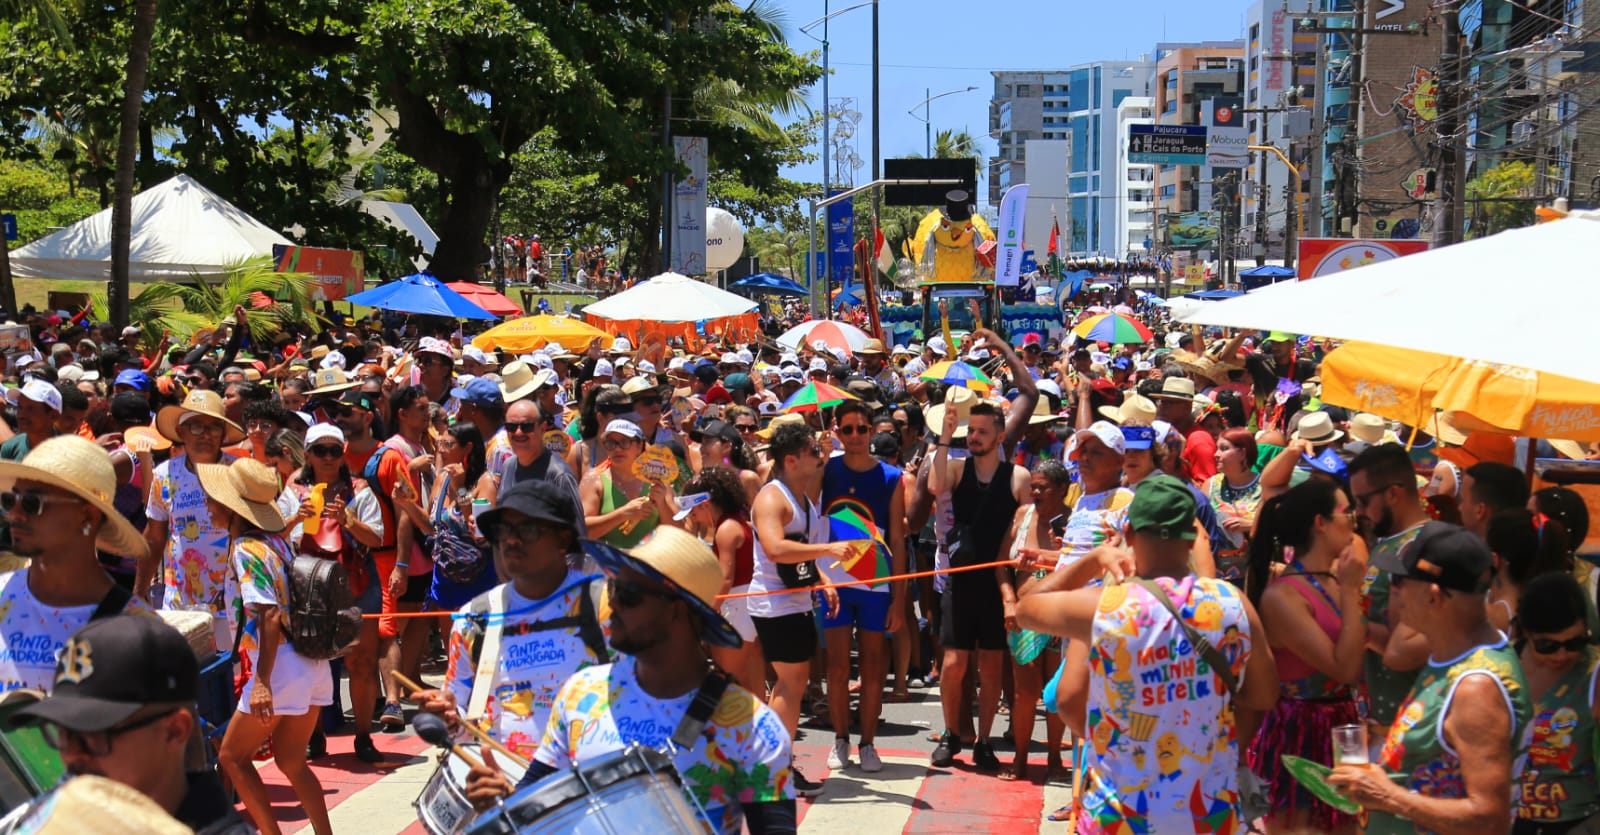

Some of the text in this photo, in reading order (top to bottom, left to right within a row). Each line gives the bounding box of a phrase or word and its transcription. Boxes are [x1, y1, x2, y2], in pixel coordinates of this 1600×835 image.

[1153, 126, 1187, 134] Pajuçara
[1152, 136, 1184, 144] Jaraguá
[1152, 144, 1169, 152] Cais
[1182, 145, 1204, 153] Porto
[706, 238, 723, 246] ono
[8, 632, 52, 650] PINTO
[618, 716, 656, 735] PINTO
[1522, 783, 1568, 802] ECA
